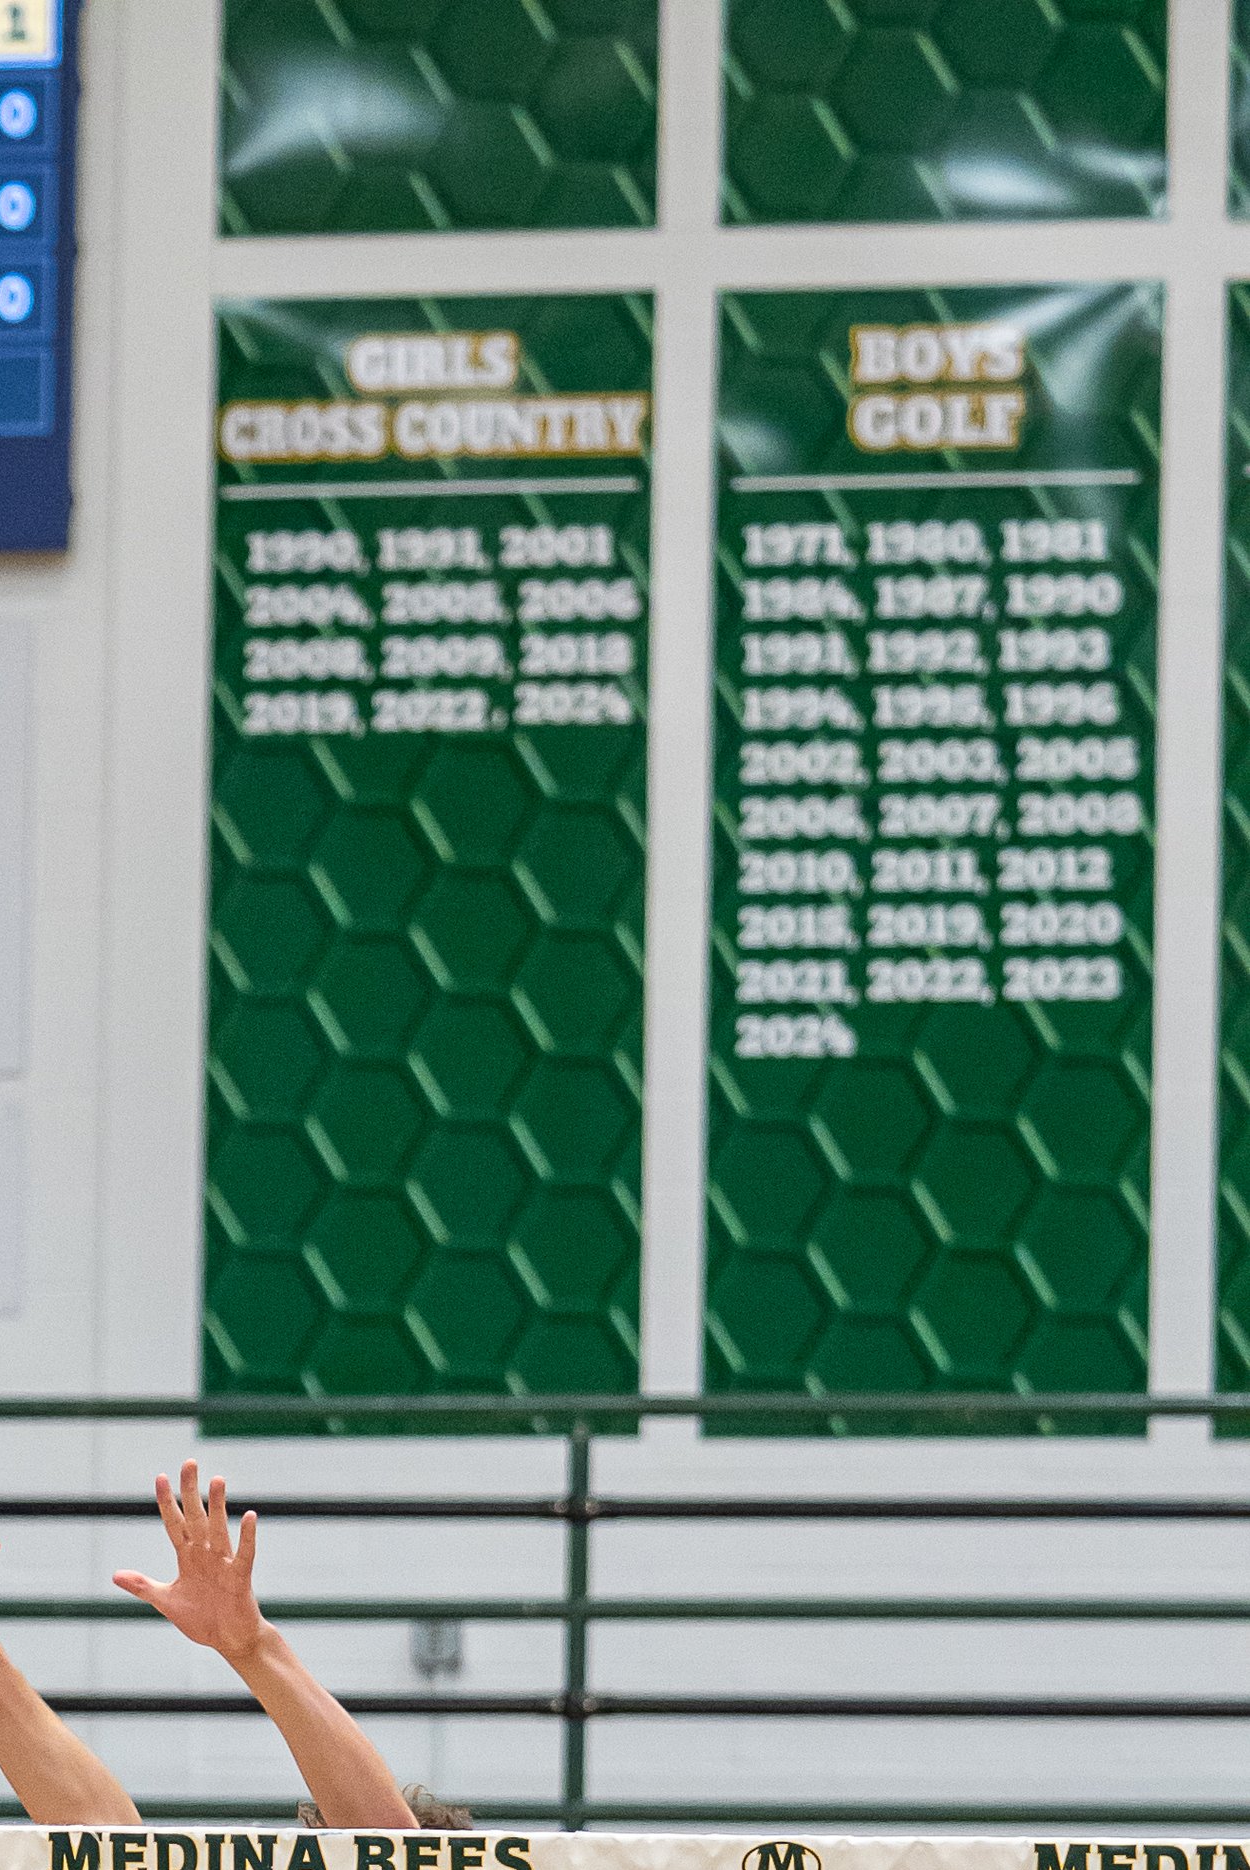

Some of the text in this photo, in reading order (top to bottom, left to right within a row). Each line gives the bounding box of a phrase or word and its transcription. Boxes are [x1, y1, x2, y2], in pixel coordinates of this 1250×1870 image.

[3, 2, 27, 42] 1
[352, 334, 516, 389] GIRLS
[854, 326, 1022, 382] BOYS
[222, 394, 644, 456] CROSS COUNTRY
[852, 394, 1022, 448] GOLF
